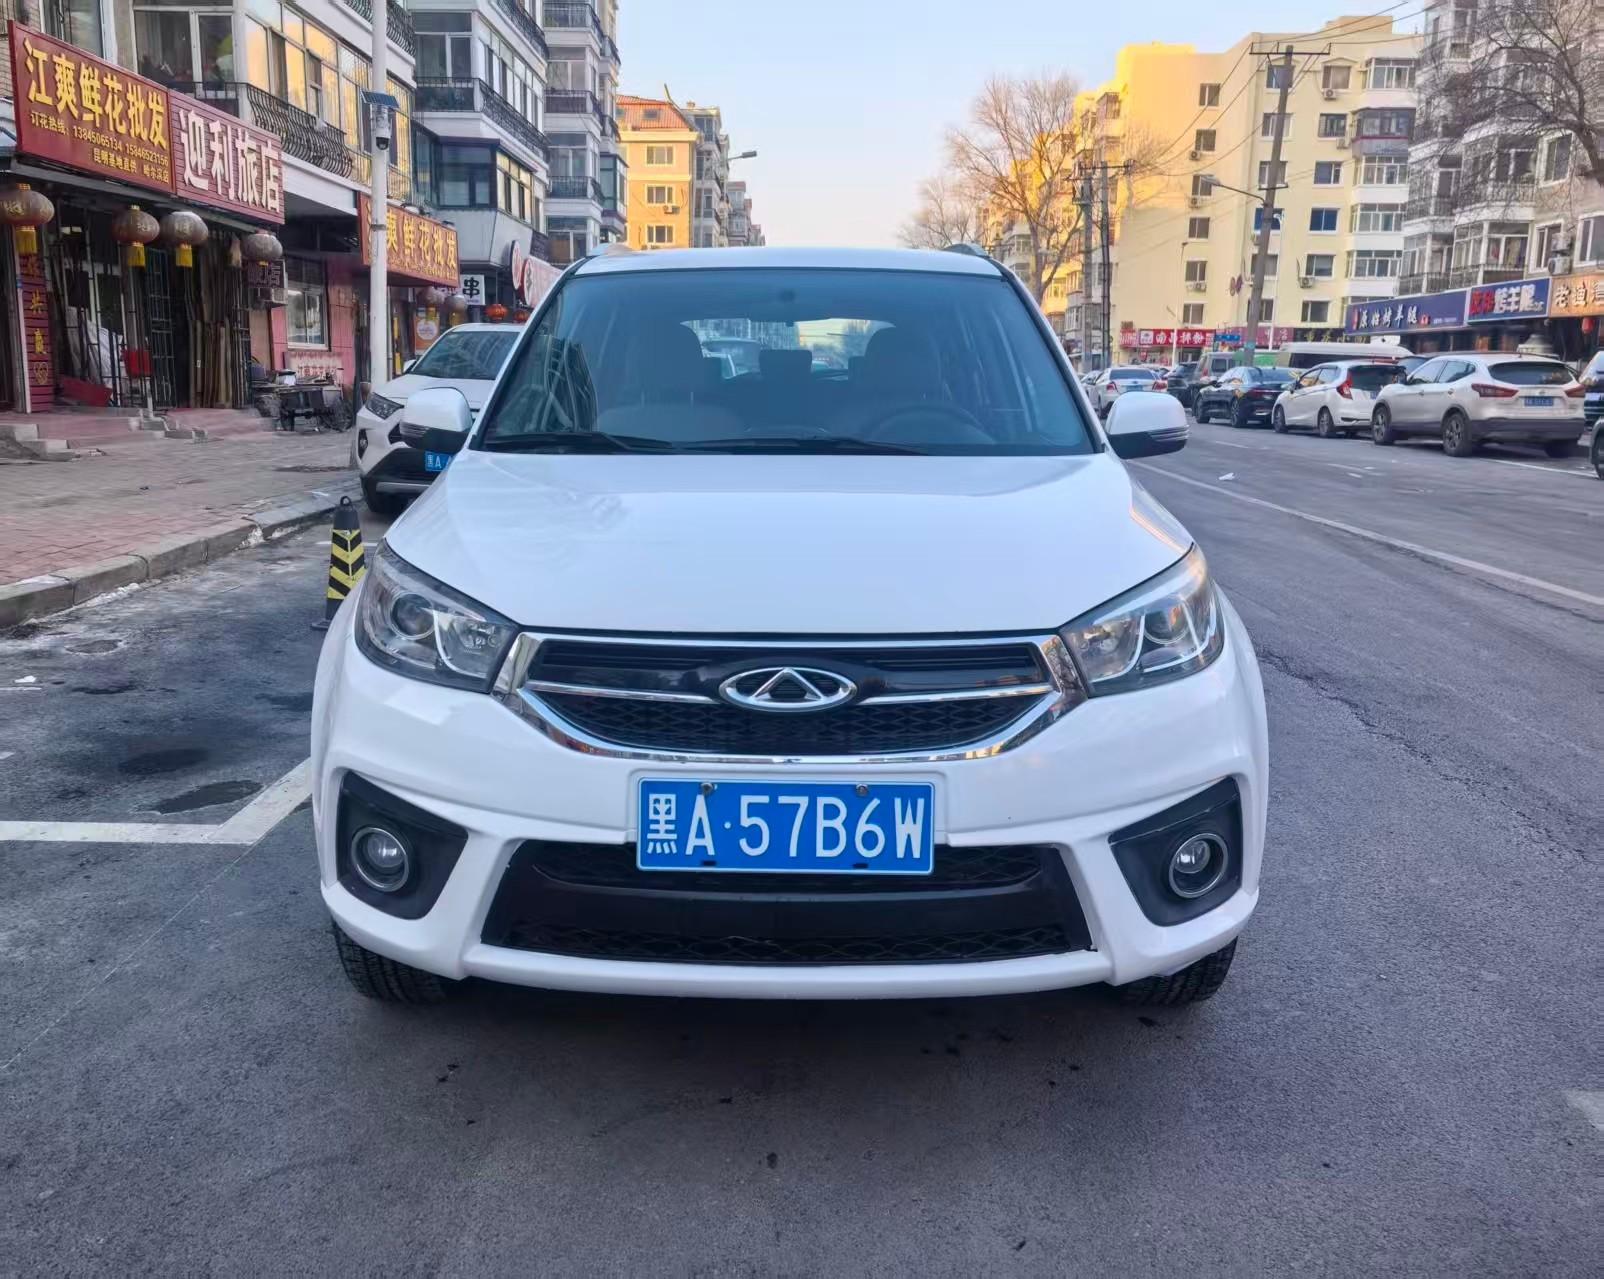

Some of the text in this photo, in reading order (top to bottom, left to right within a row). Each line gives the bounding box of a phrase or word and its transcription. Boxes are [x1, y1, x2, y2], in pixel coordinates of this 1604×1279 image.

[24, 38, 167, 149] 江爽鲜花批发
[178, 108, 281, 213] 迎利旅店
[366, 201, 457, 269] 爽鲜花批发
[462, 276, 480, 299] 串
